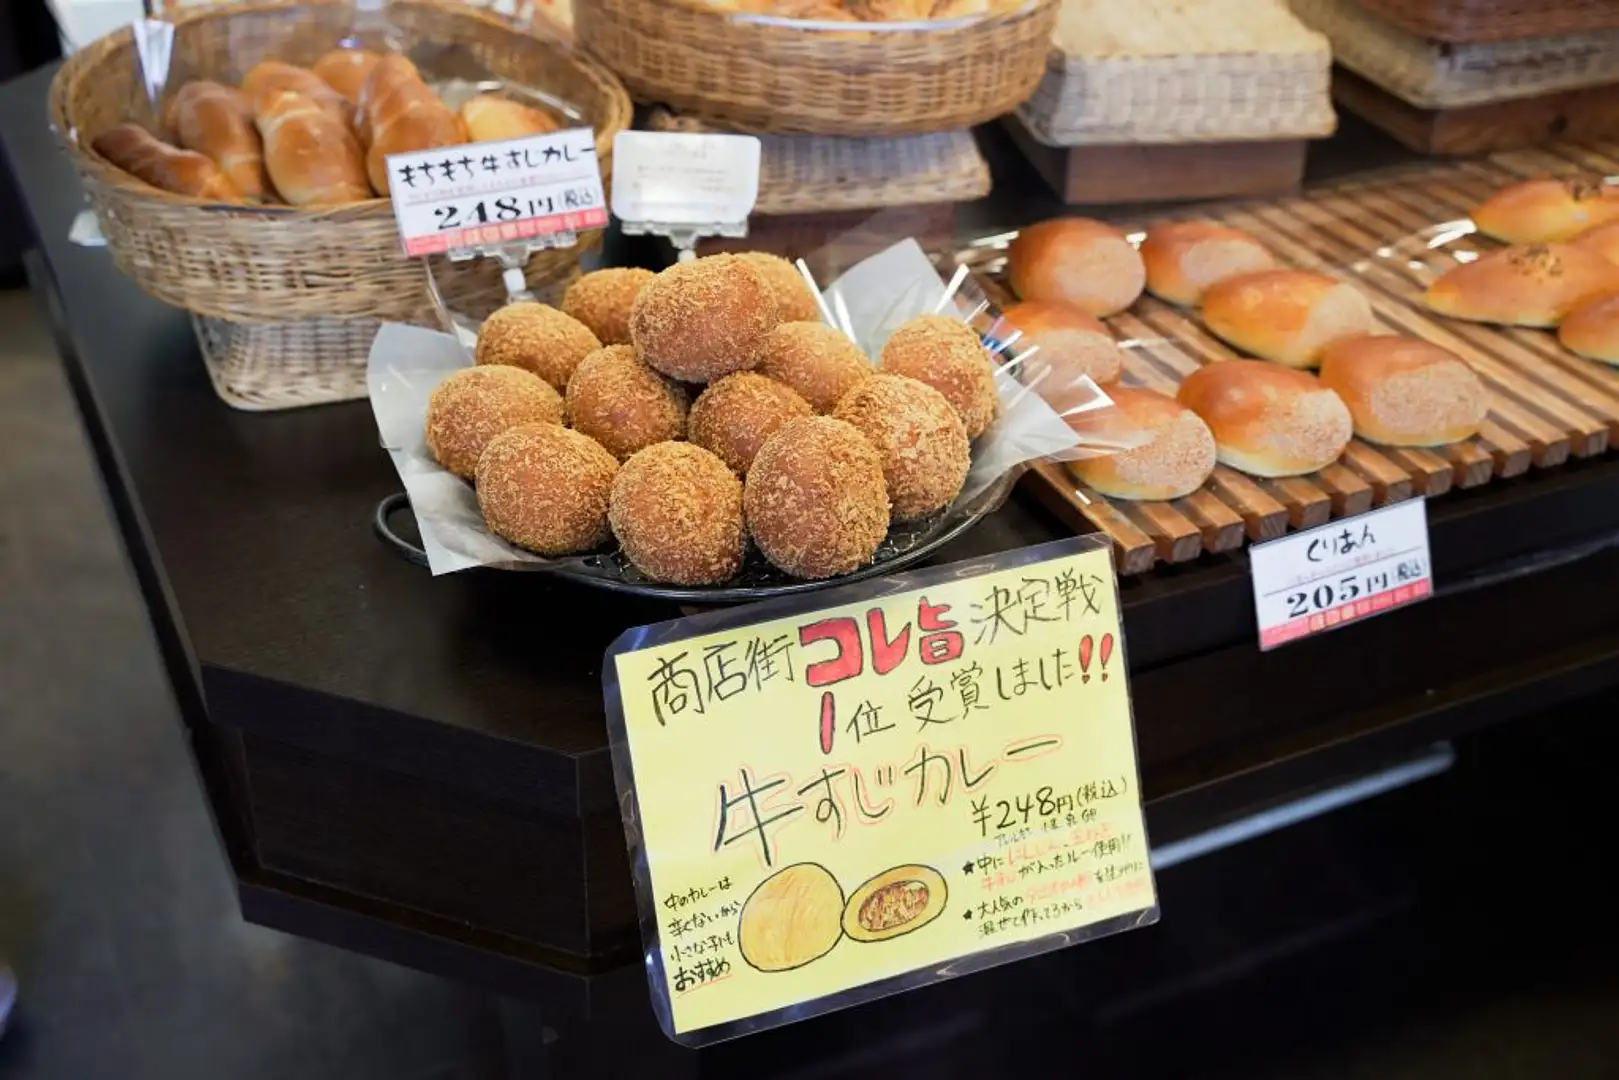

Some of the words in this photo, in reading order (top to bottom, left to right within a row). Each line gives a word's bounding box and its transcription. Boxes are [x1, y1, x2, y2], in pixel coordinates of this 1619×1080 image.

[713, 739, 1060, 867] 牛すじカレー
